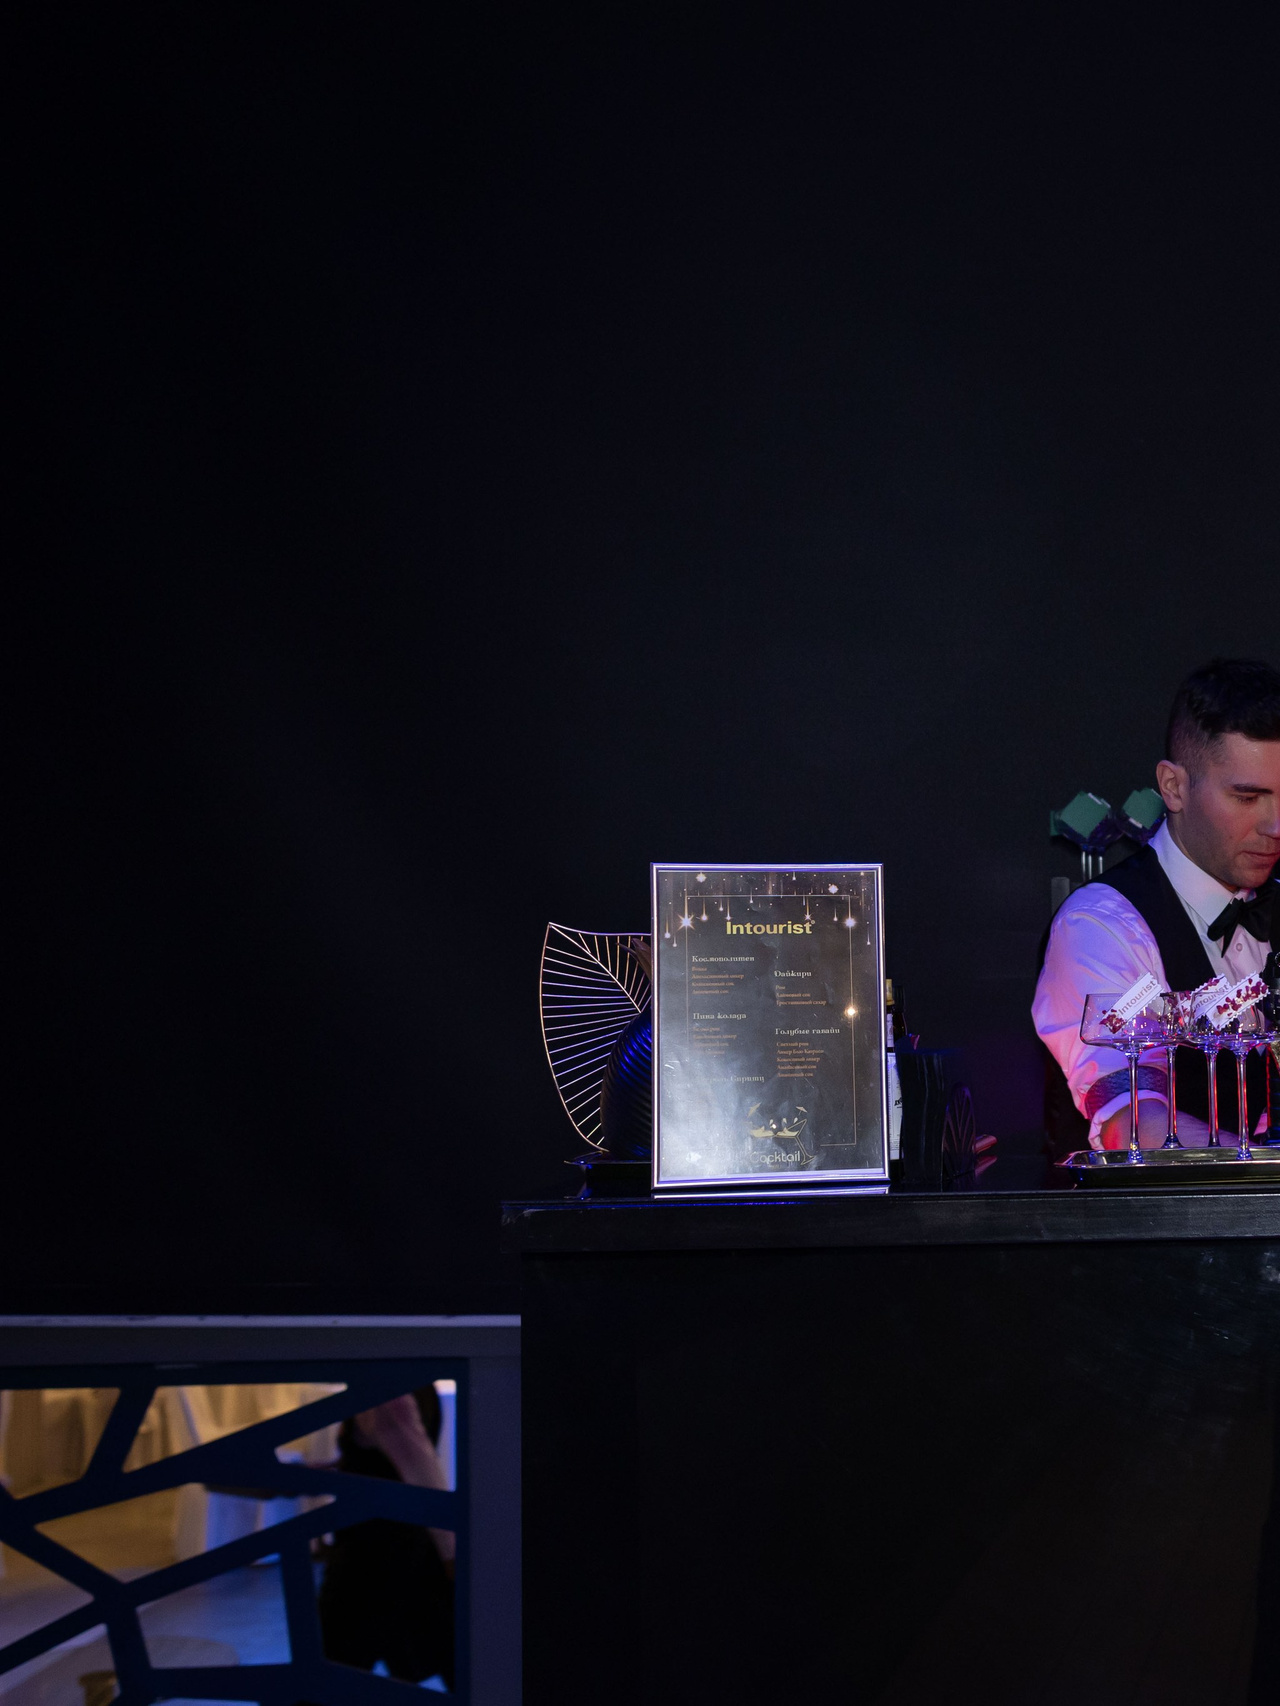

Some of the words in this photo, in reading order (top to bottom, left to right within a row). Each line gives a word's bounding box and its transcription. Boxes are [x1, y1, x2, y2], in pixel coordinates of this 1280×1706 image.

[726, 920, 813, 935] Intourist
[774, 970, 812, 979] Дайкири
[1118, 980, 1156, 1016] Intourist
[775, 1027, 810, 1036] Голубые
